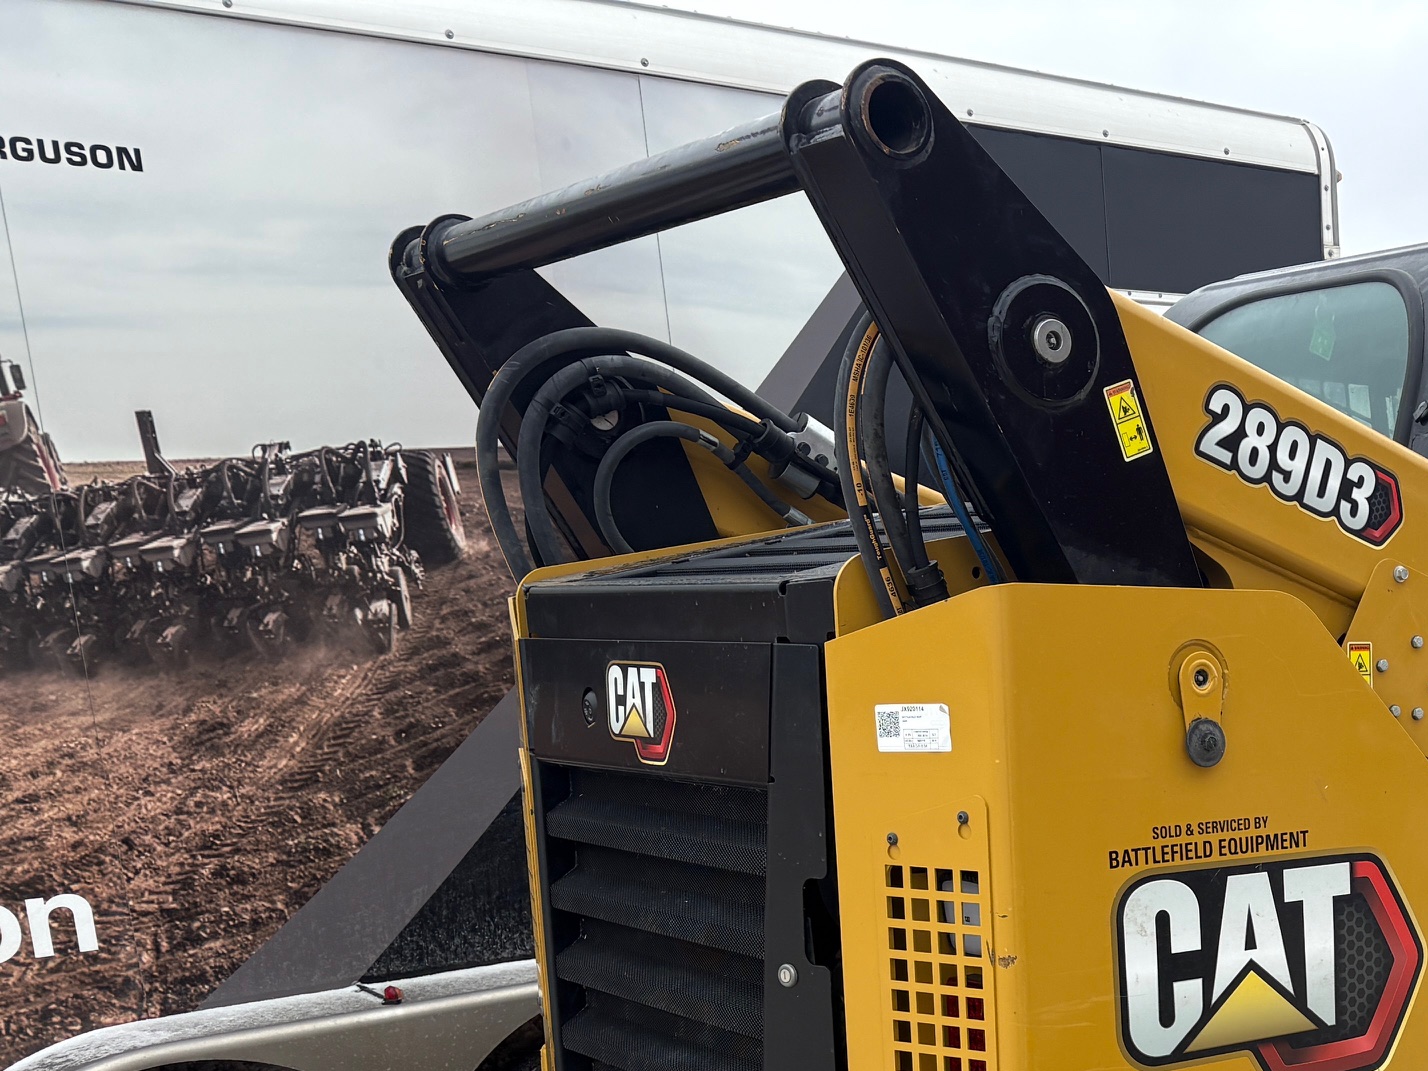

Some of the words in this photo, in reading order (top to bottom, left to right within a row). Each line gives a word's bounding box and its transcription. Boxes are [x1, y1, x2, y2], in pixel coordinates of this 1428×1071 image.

[1200, 389, 1376, 531] 289D3
[885, 576, 897, 598] 4636
[608, 665, 657, 738] CAT
[1108, 840, 1213, 869] BATTLEFIELD
[1218, 829, 1309, 857] EQUIPMENT
[1152, 824, 1182, 840] SOLD
[1185, 822, 1194, 836] &
[1197, 818, 1250, 835] SERVICED
[1254, 815, 1268, 829] BY
[1123, 861, 1351, 1058] CAT
